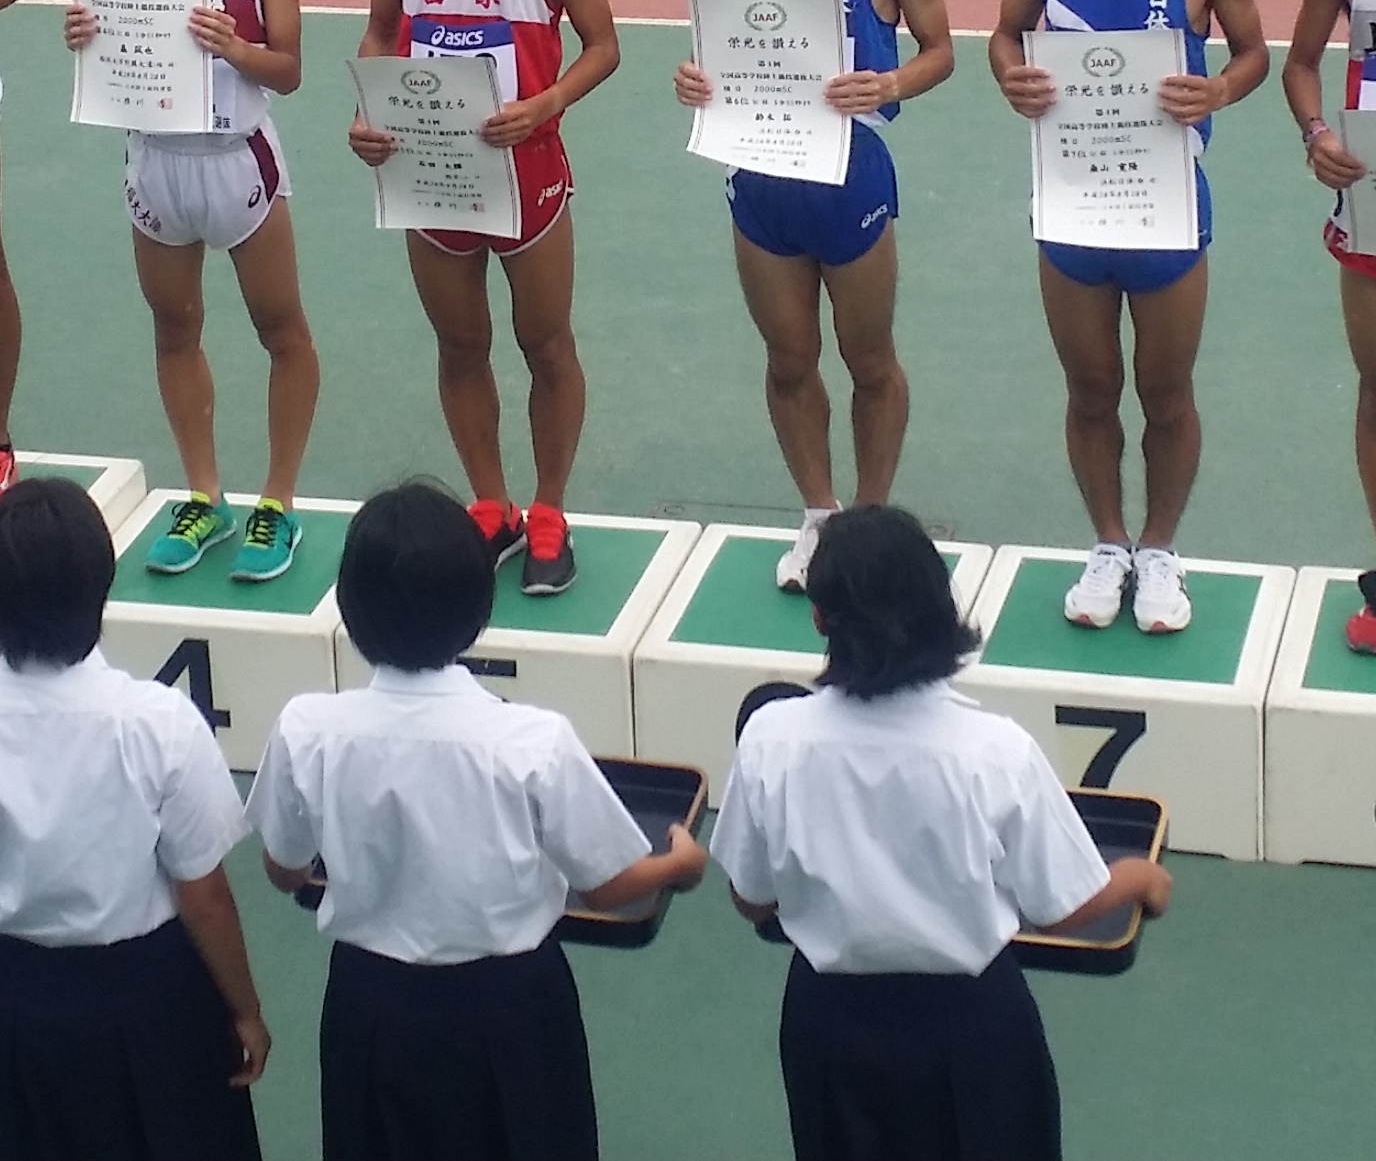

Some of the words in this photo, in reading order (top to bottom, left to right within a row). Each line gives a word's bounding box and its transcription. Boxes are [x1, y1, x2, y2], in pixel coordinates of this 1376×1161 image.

[753, 13, 778, 22] JAAF
[1090, 58, 1117, 68] JAAF
[1054, 704, 1147, 789] 7
